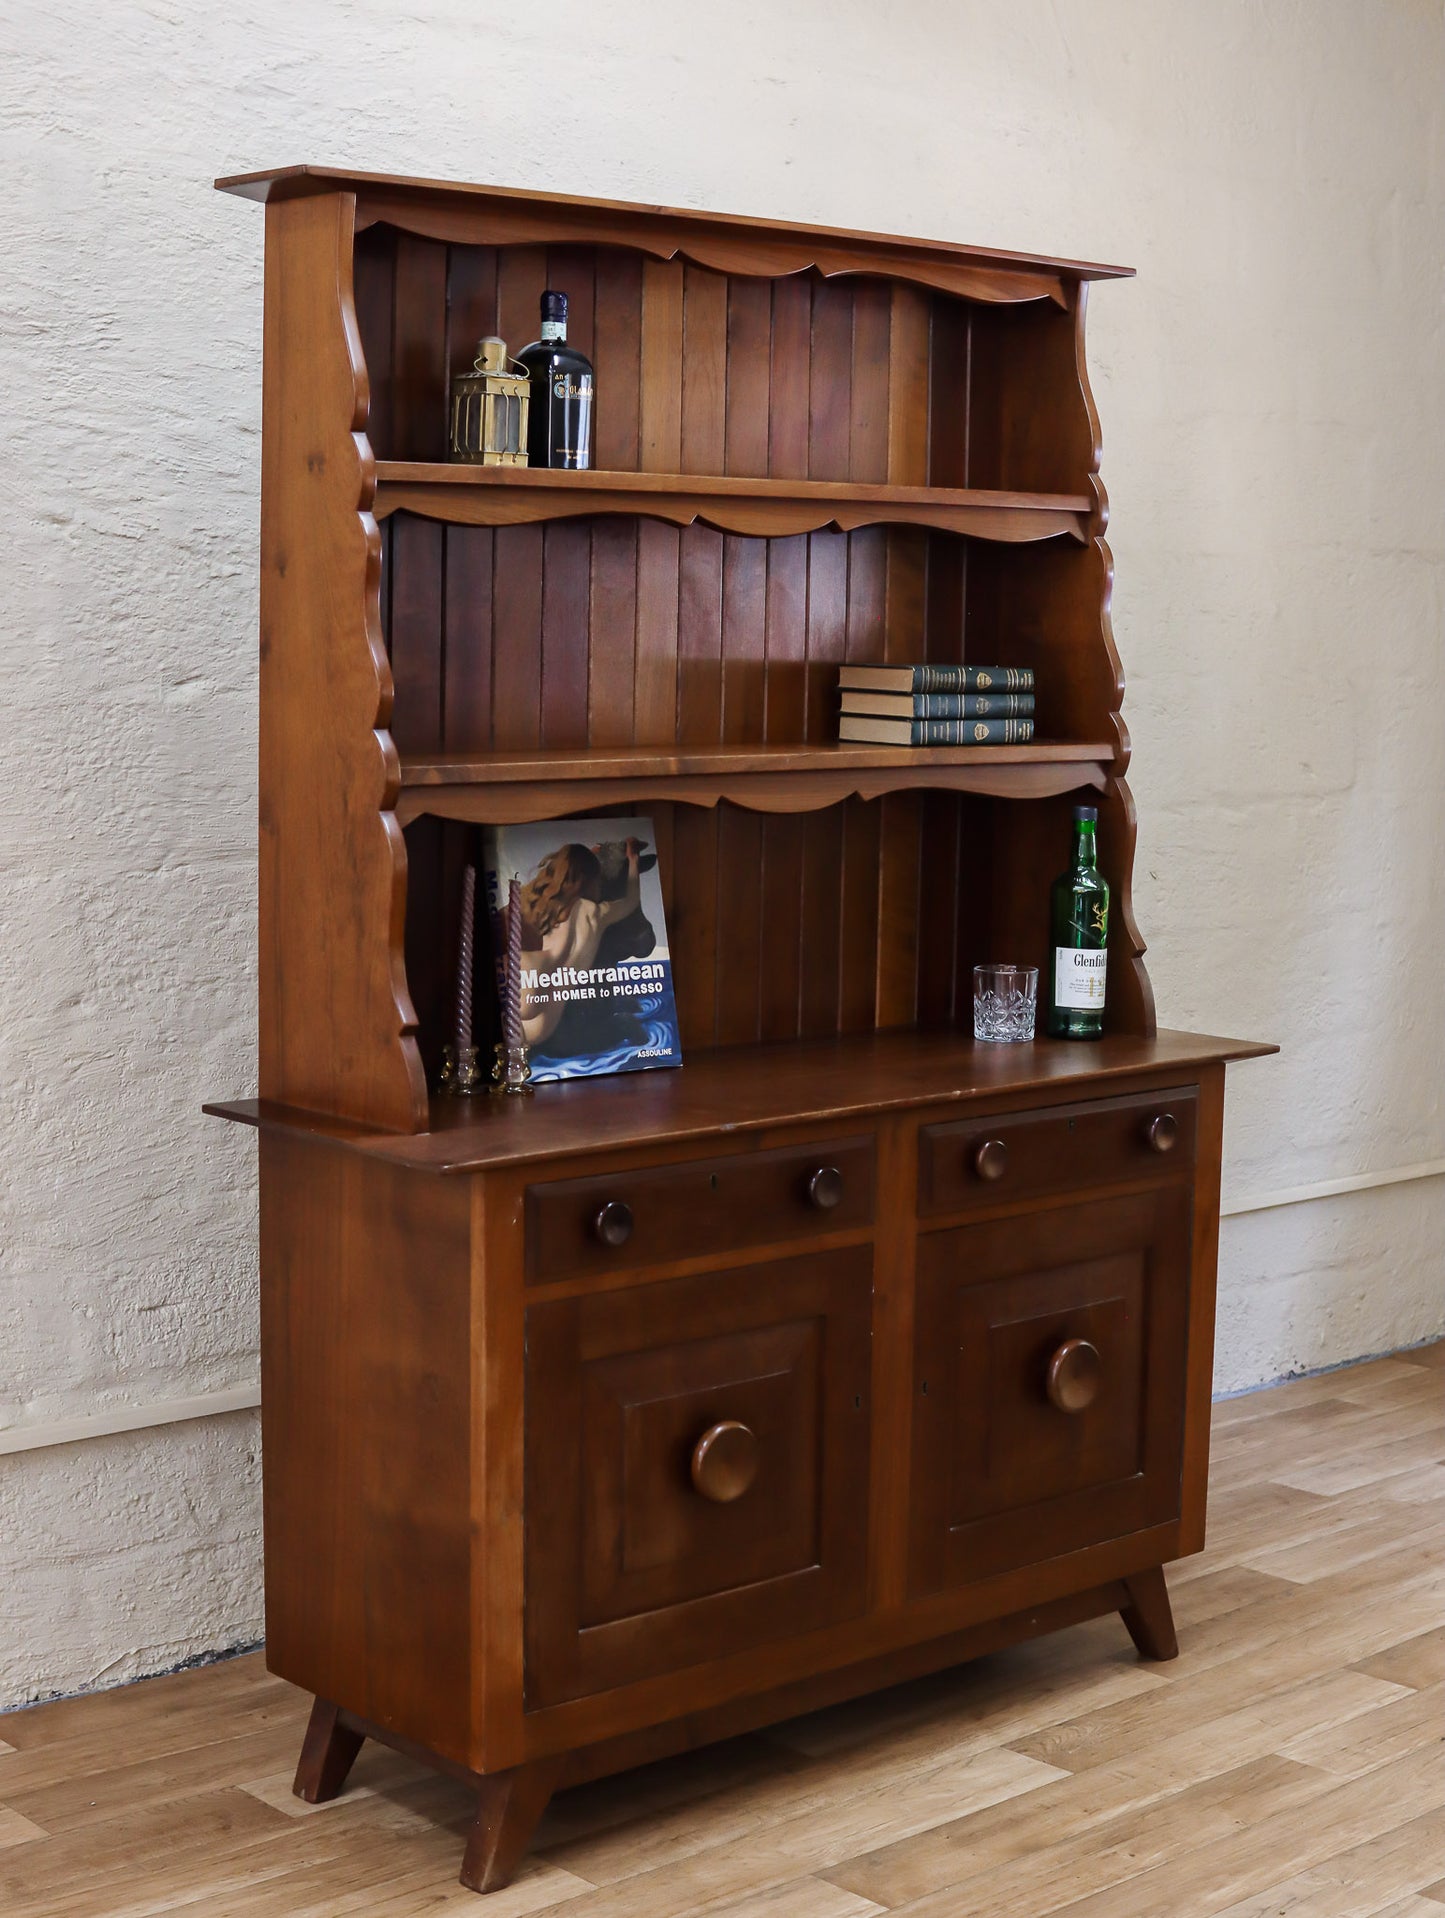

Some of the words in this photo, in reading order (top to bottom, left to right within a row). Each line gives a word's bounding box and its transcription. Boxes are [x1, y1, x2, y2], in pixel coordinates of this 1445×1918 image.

[519, 964, 664, 989] Mediterranean
[525, 994, 549, 1004] from
[553, 988, 596, 1002] HOMER
[599, 988, 610, 998] to
[612, 982, 664, 996] PICASSO
